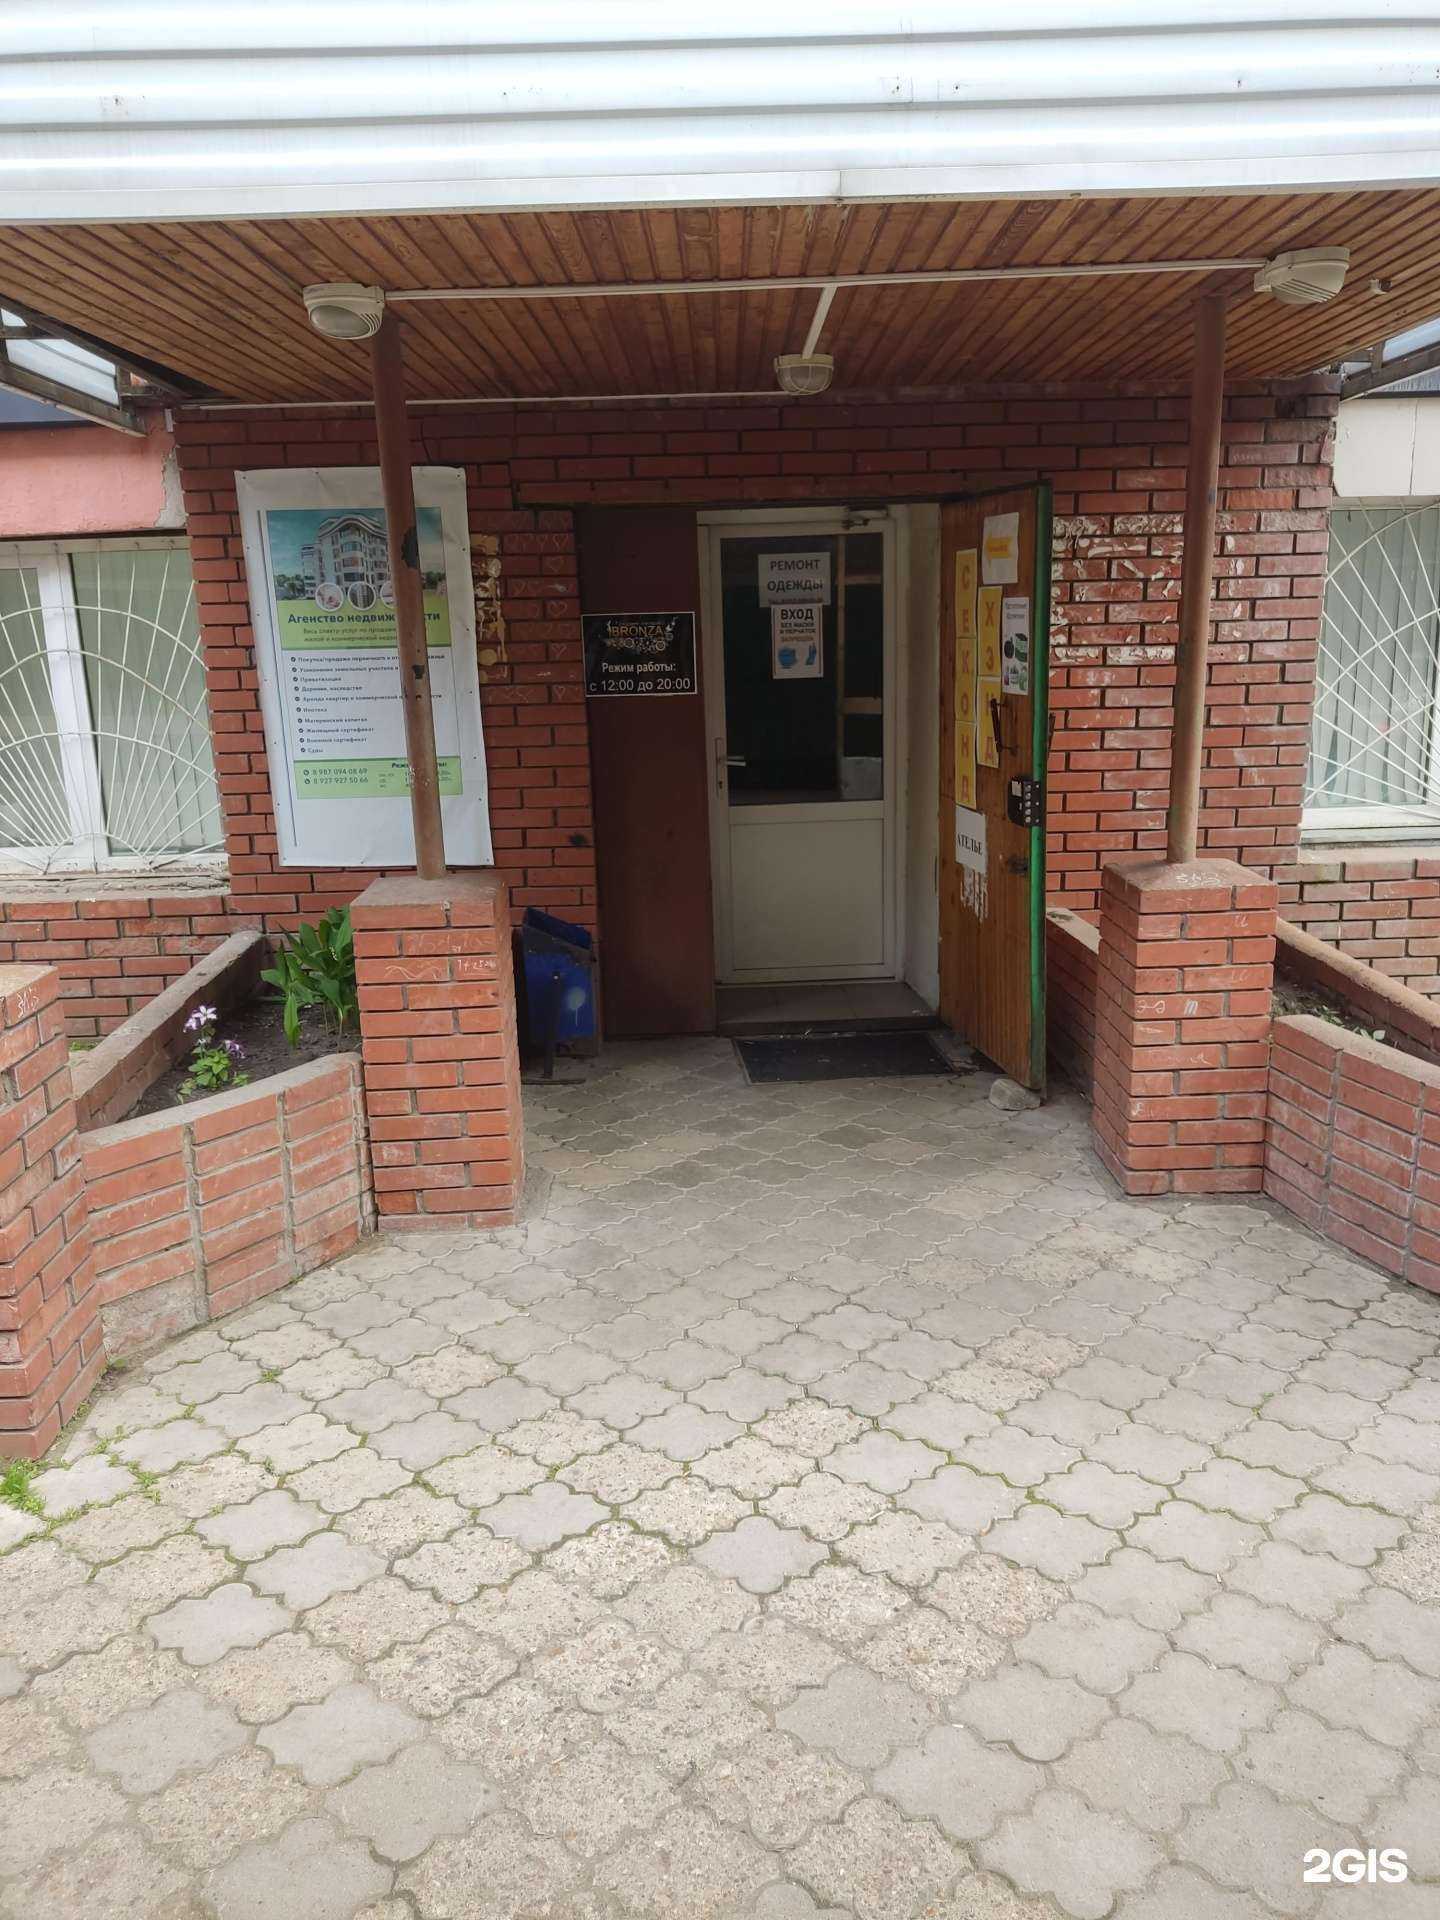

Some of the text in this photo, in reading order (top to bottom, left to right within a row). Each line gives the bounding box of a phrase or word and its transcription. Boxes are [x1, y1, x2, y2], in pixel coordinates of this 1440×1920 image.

[770, 559, 821, 571] РЕМОНТ
[288, 613, 344, 624] Агенство
[780, 608, 814, 621] ВХОД
[611, 625, 664, 637] BRONZA
[602, 661, 677, 675] Режим работы:
[589, 678, 691, 692] с 12:00 до 20:00
